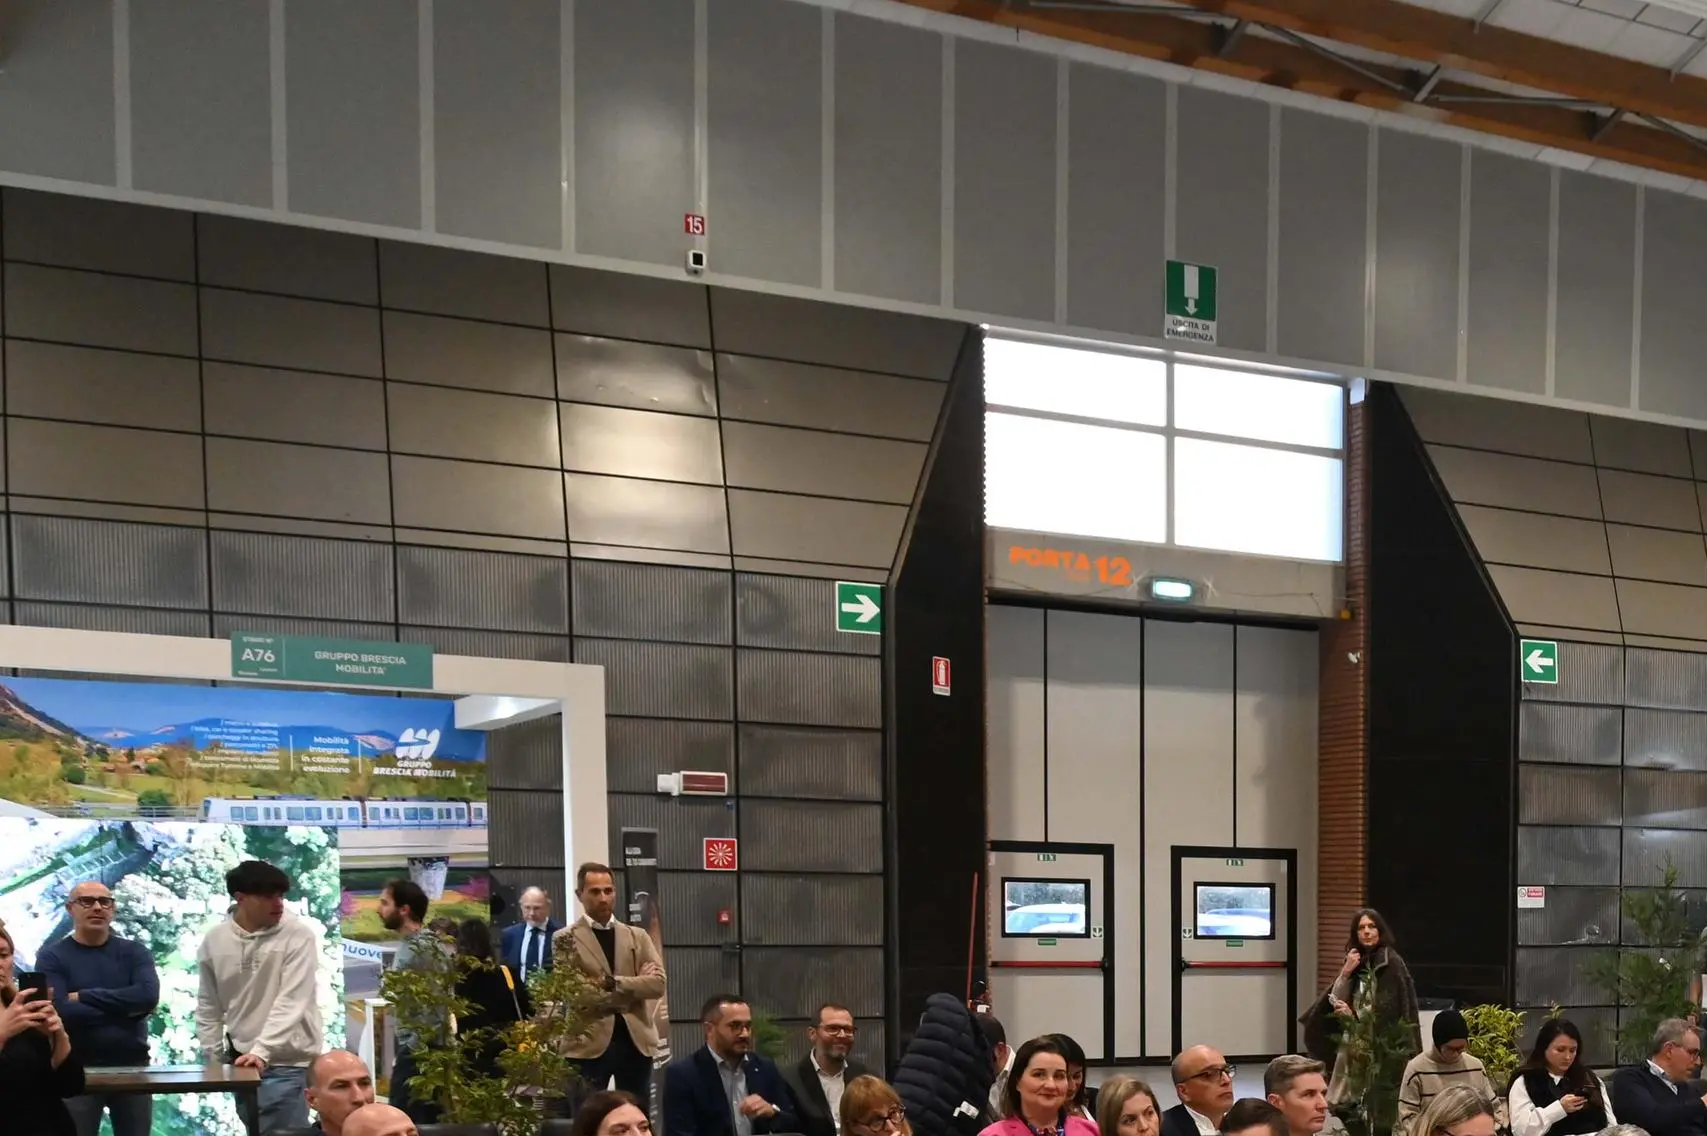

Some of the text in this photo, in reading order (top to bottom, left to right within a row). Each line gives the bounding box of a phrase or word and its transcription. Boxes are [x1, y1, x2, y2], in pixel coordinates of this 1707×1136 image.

[687, 216, 703, 234] 15
[1009, 546, 1090, 570] PORTA
[1096, 556, 1132, 586] 12
[241, 648, 275, 663] A76
[314, 651, 406, 665] GRUPPO BRESCIA
[397, 760, 432, 769] GRUPPO
